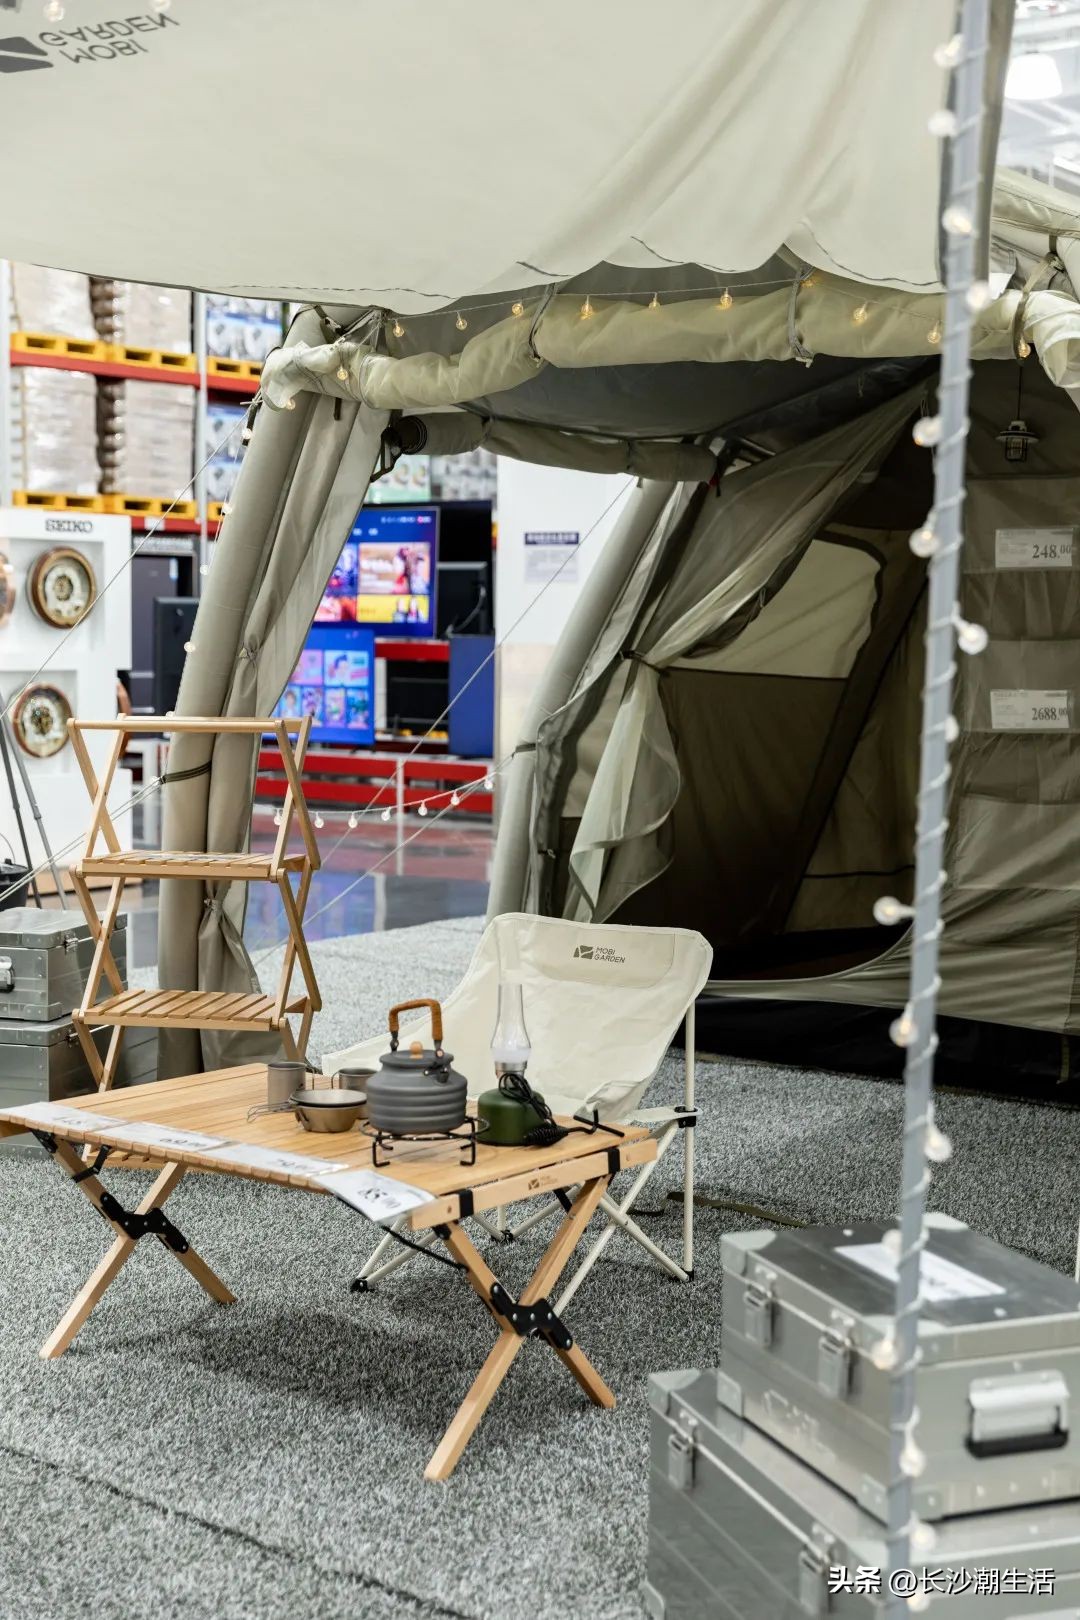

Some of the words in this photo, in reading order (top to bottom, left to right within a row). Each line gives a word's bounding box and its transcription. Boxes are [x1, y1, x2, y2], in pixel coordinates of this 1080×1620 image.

[45, 519, 94, 533] SEIKO
[1032, 544, 1072, 559] 248.00
[596, 947, 616, 956] MOBI
[594, 954, 626, 963] GARDEN
